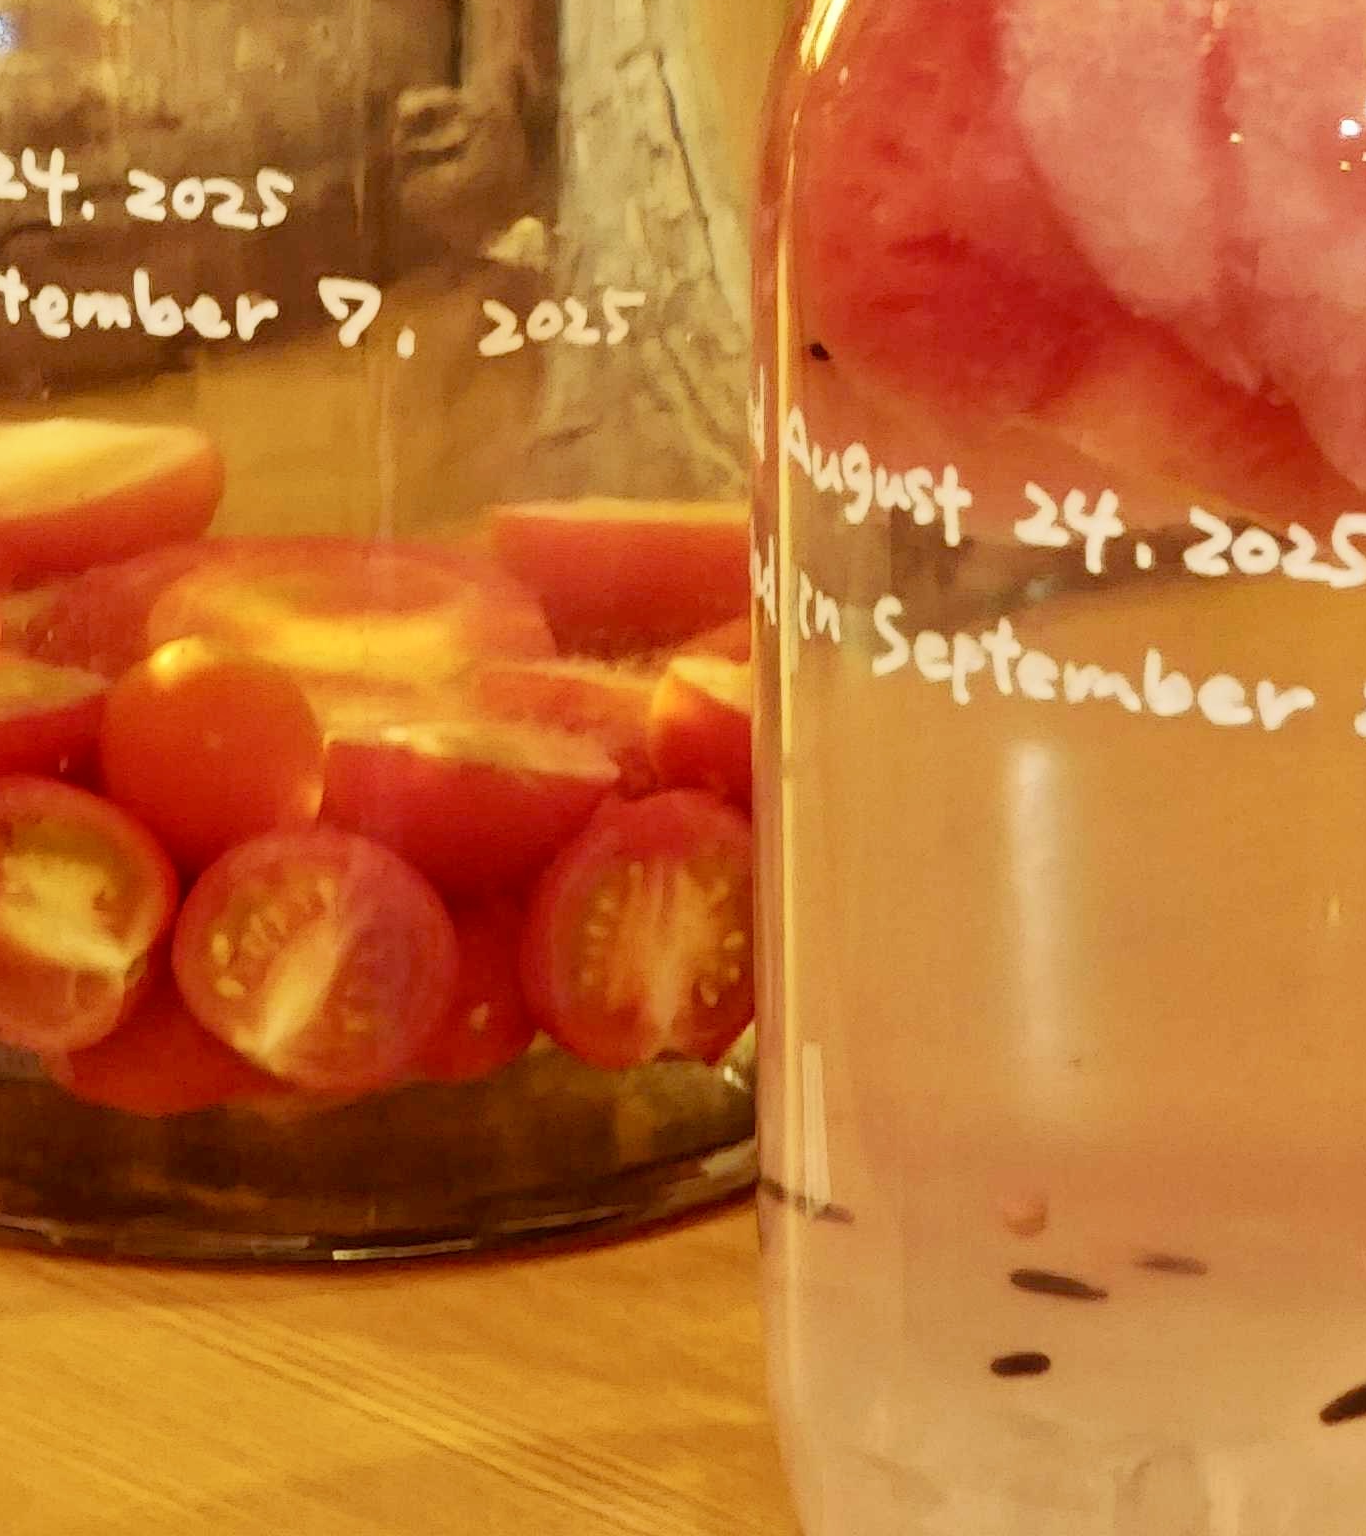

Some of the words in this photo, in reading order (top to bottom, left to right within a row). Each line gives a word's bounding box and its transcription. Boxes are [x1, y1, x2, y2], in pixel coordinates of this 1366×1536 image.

[125, 167, 295, 229] 2025
[480, 289, 646, 358] 2025
[785, 405, 972, 546] August
[872, 595, 1316, 732] September
